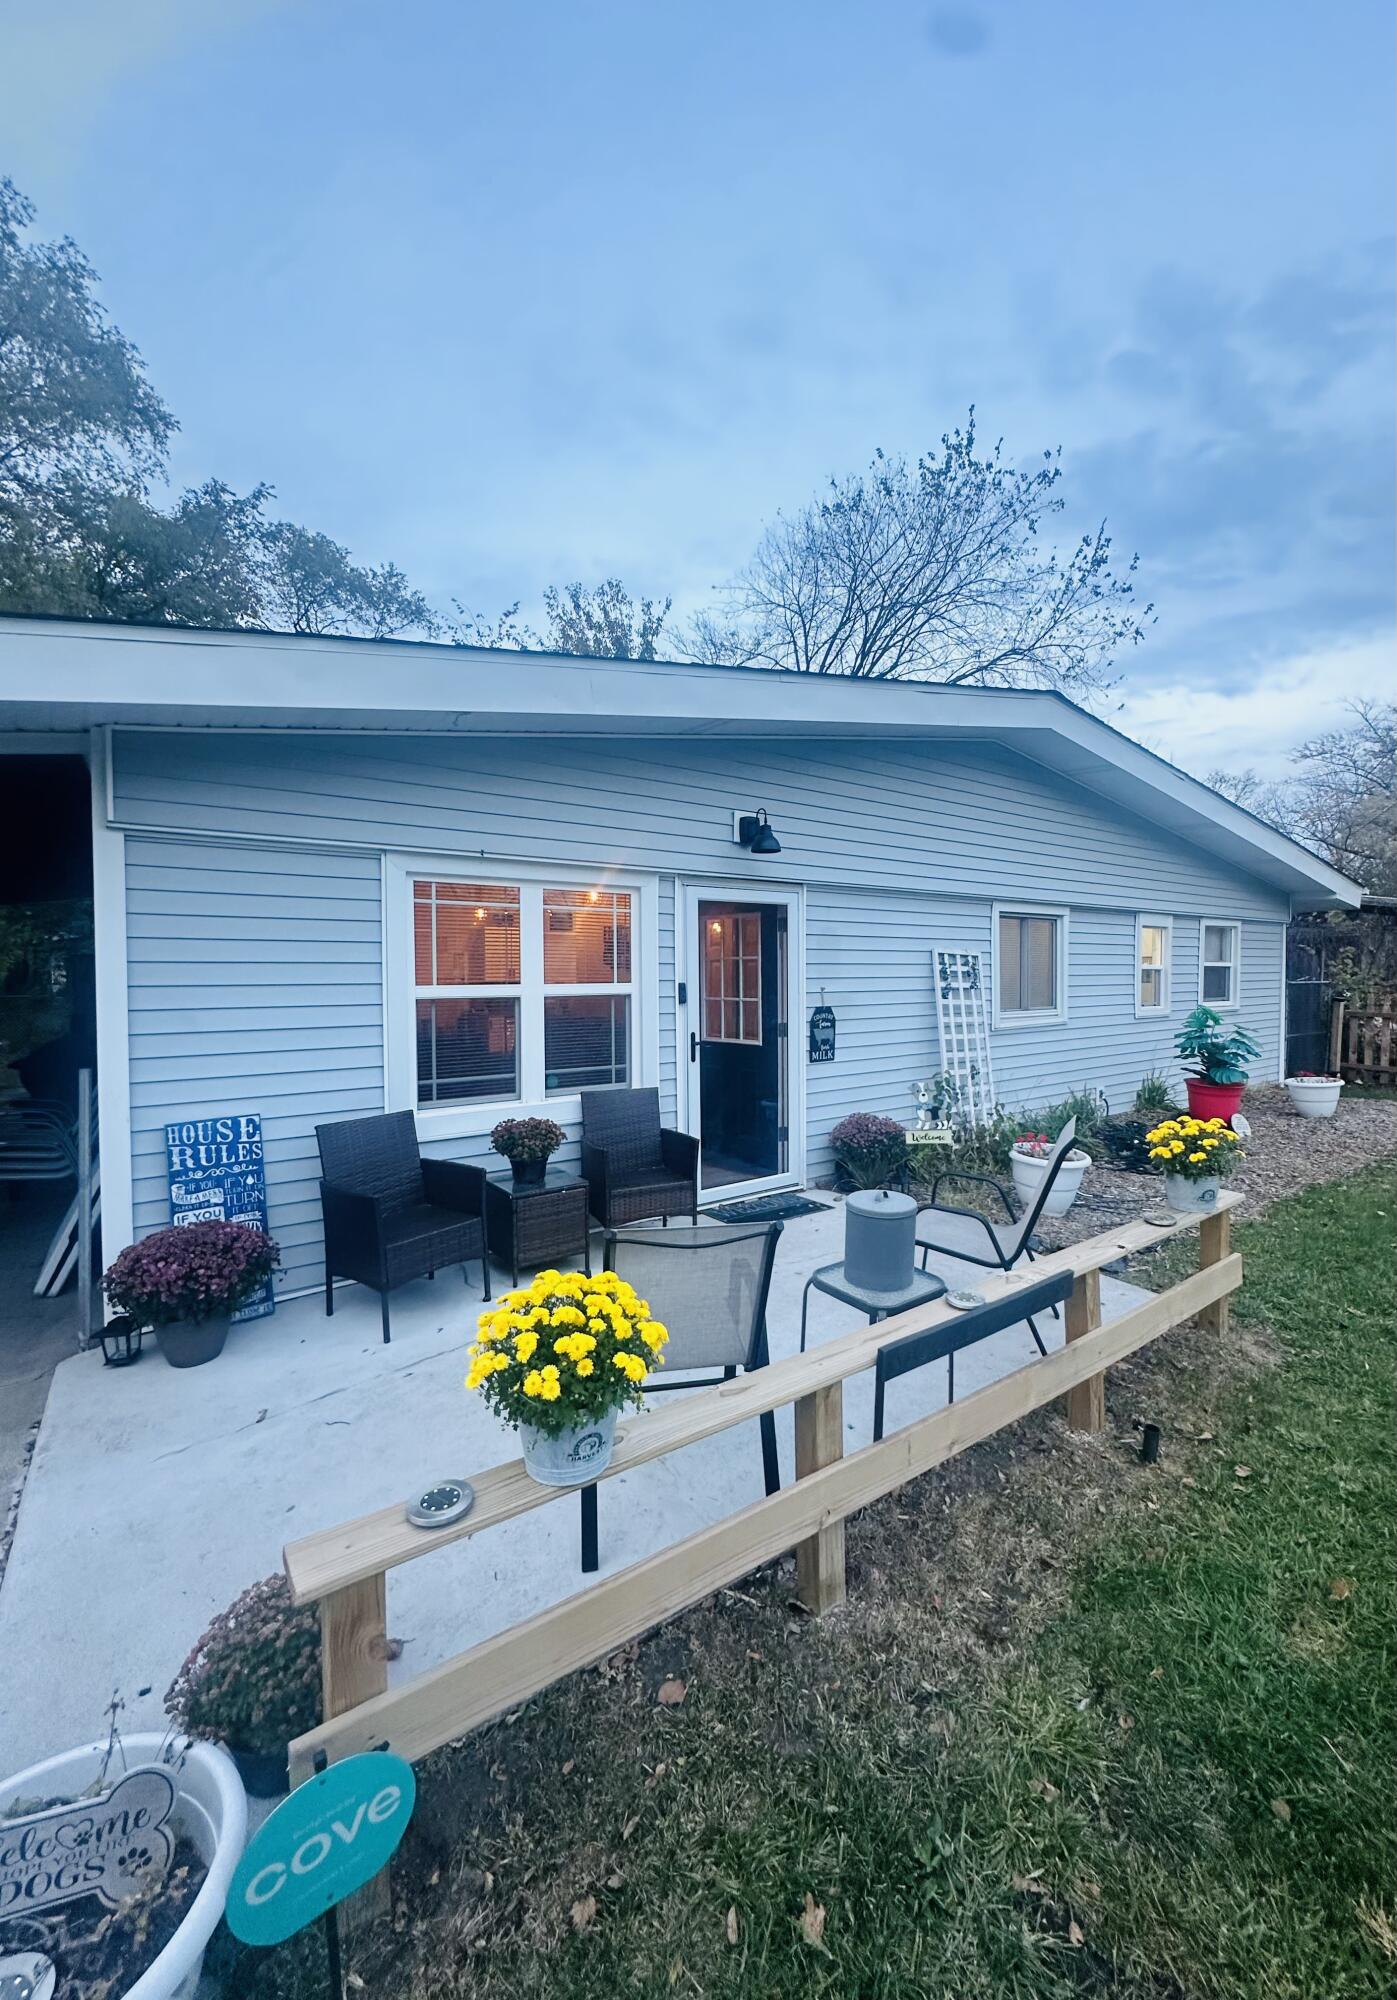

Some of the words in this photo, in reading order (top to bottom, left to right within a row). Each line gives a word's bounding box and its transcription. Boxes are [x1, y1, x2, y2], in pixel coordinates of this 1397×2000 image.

[812, 1050, 834, 1060] MILK
[167, 1115, 260, 1145] HOUSE
[912, 1132, 945, 1142] Welcome
[168, 1143, 262, 1171] RULES
[189, 1182, 196, 1192] IF
[199, 1180, 215, 1190] YOU
[225, 1177, 236, 1189] IF
[224, 1190, 264, 1207] TURN
[177, 1215, 189, 1226] IF
[193, 1208, 221, 1222] YOU
[0, 1808, 151, 1868] elcome
[245, 1786, 400, 1905] cove
